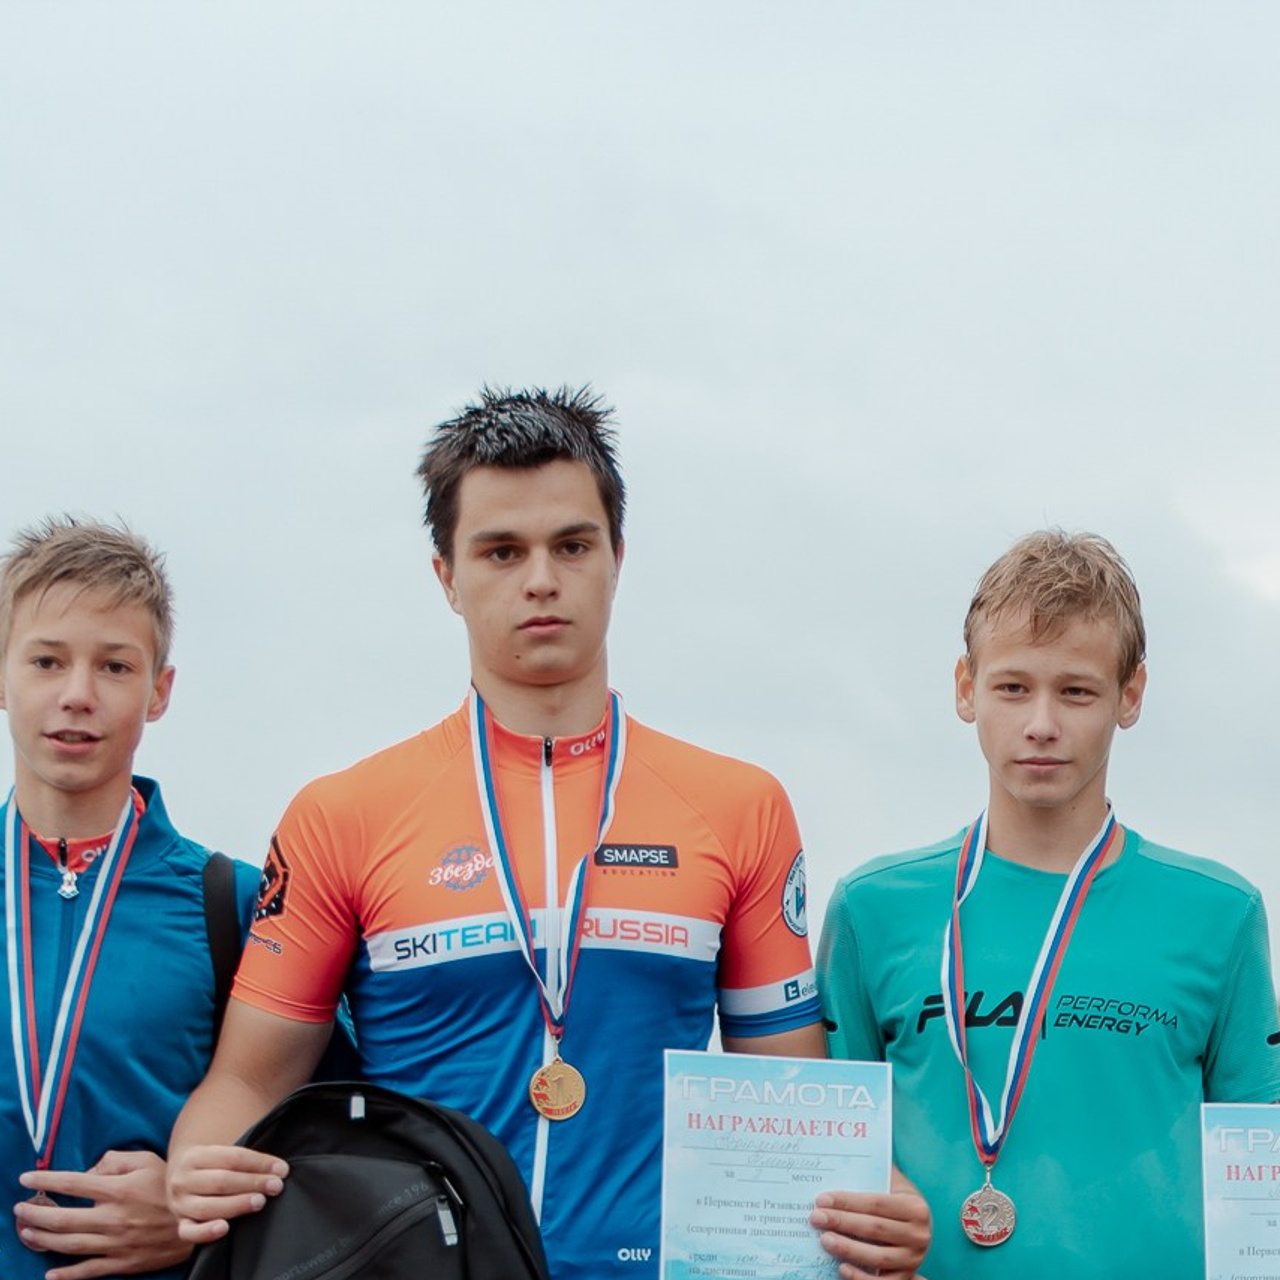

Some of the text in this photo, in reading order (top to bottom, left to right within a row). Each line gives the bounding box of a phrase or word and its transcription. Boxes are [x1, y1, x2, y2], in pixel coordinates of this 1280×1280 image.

[603, 849, 670, 864] SMAPSE
[602, 869, 676, 877] EDUCATION
[1056, 994, 1179, 1029] PERFORMA
[1053, 1013, 1149, 1036] ENERGY
[681, 1075, 878, 1109] ГРАМОТА
[687, 1113, 867, 1138] НАГРАЖДАЕТСЯ
[791, 1174, 823, 1183] место
[703, 1197, 757, 1209] Первенстве
[618, 1248, 651, 1261] OLLY
